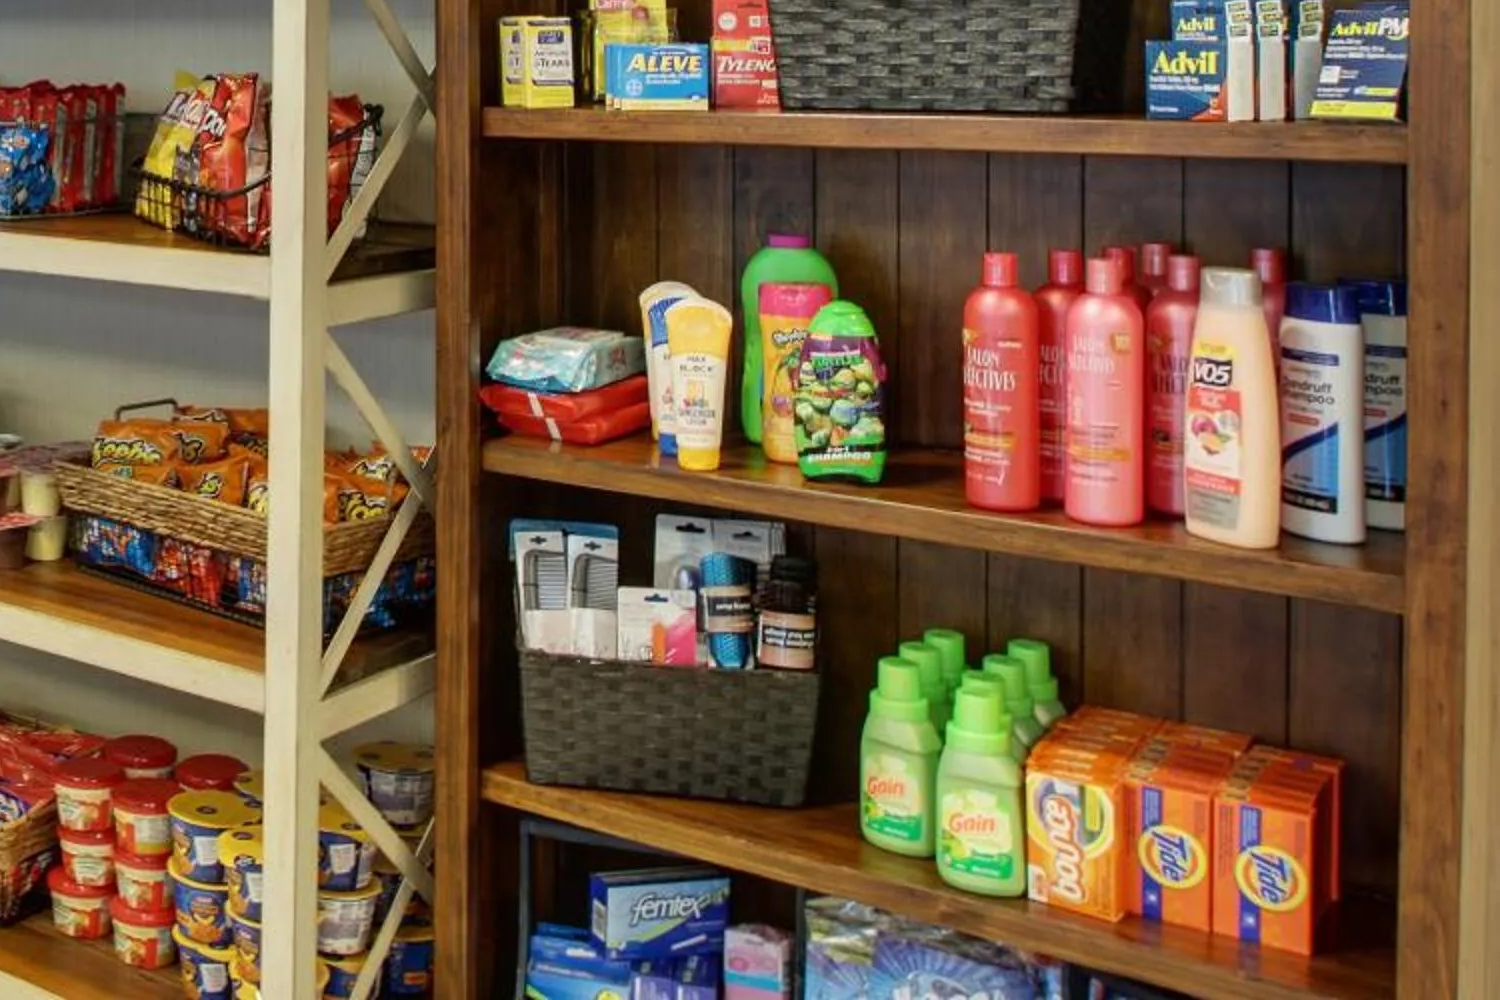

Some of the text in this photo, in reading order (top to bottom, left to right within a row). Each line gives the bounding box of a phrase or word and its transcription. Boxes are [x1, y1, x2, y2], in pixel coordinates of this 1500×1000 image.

[1175, 16, 1216, 32] Advil
[1332, 21, 1377, 37] Advil
[627, 52, 702, 73] ALEVE
[717, 55, 776, 73] TYLENO
[1152, 49, 1220, 75] Advil
[1194, 364, 1232, 384] VO5
[867, 776, 906, 797] Gain
[949, 813, 997, 833] Gain
[1043, 796, 1086, 904] bounce
[1151, 830, 1187, 883] Tide
[1248, 851, 1287, 904] Tide
[628, 891, 701, 928] femtex
